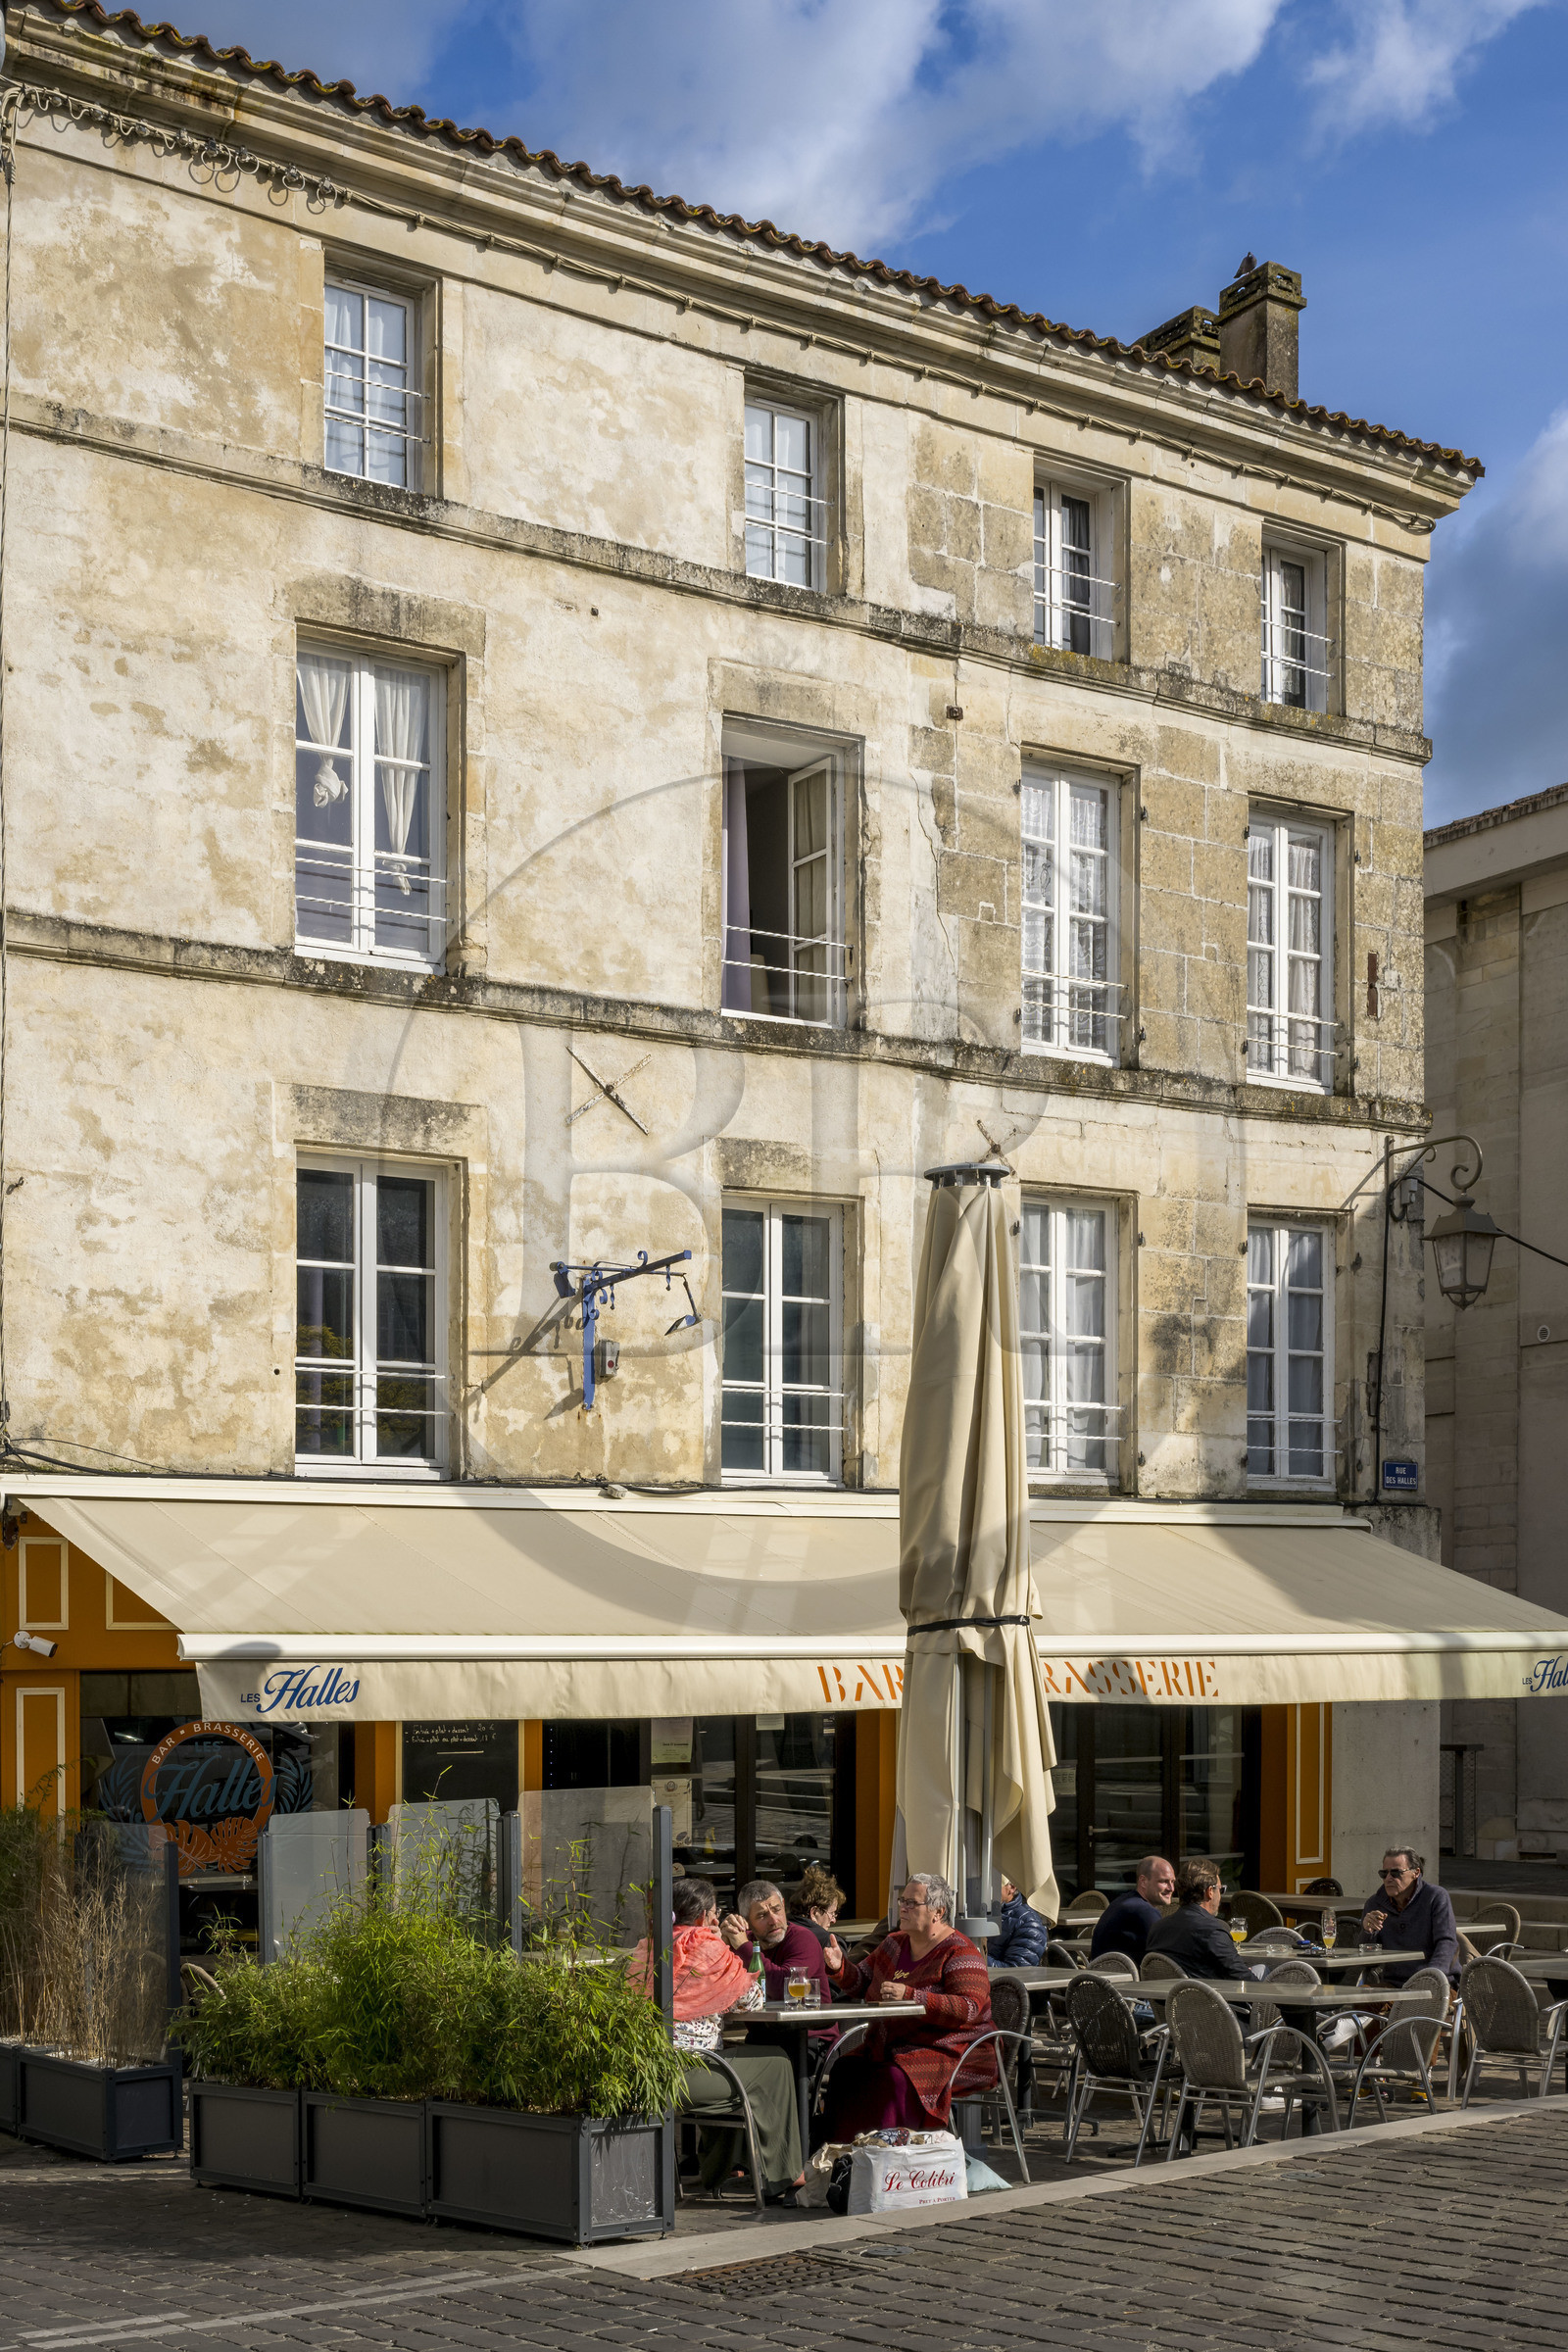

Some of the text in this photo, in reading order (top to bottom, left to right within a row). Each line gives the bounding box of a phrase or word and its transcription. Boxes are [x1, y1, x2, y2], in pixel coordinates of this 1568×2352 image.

[240, 1665, 360, 1713] LES Halles
[817, 1661, 1218, 1702] BAR RASSERIE
[1530, 1655, 1568, 1692] Hal
[152, 1722, 265, 1764] BAR BRASSERIE
[195, 1741, 221, 1752] LES
[144, 1755, 278, 1823] Halles
[882, 2169, 956, 2192] Le Colibri
